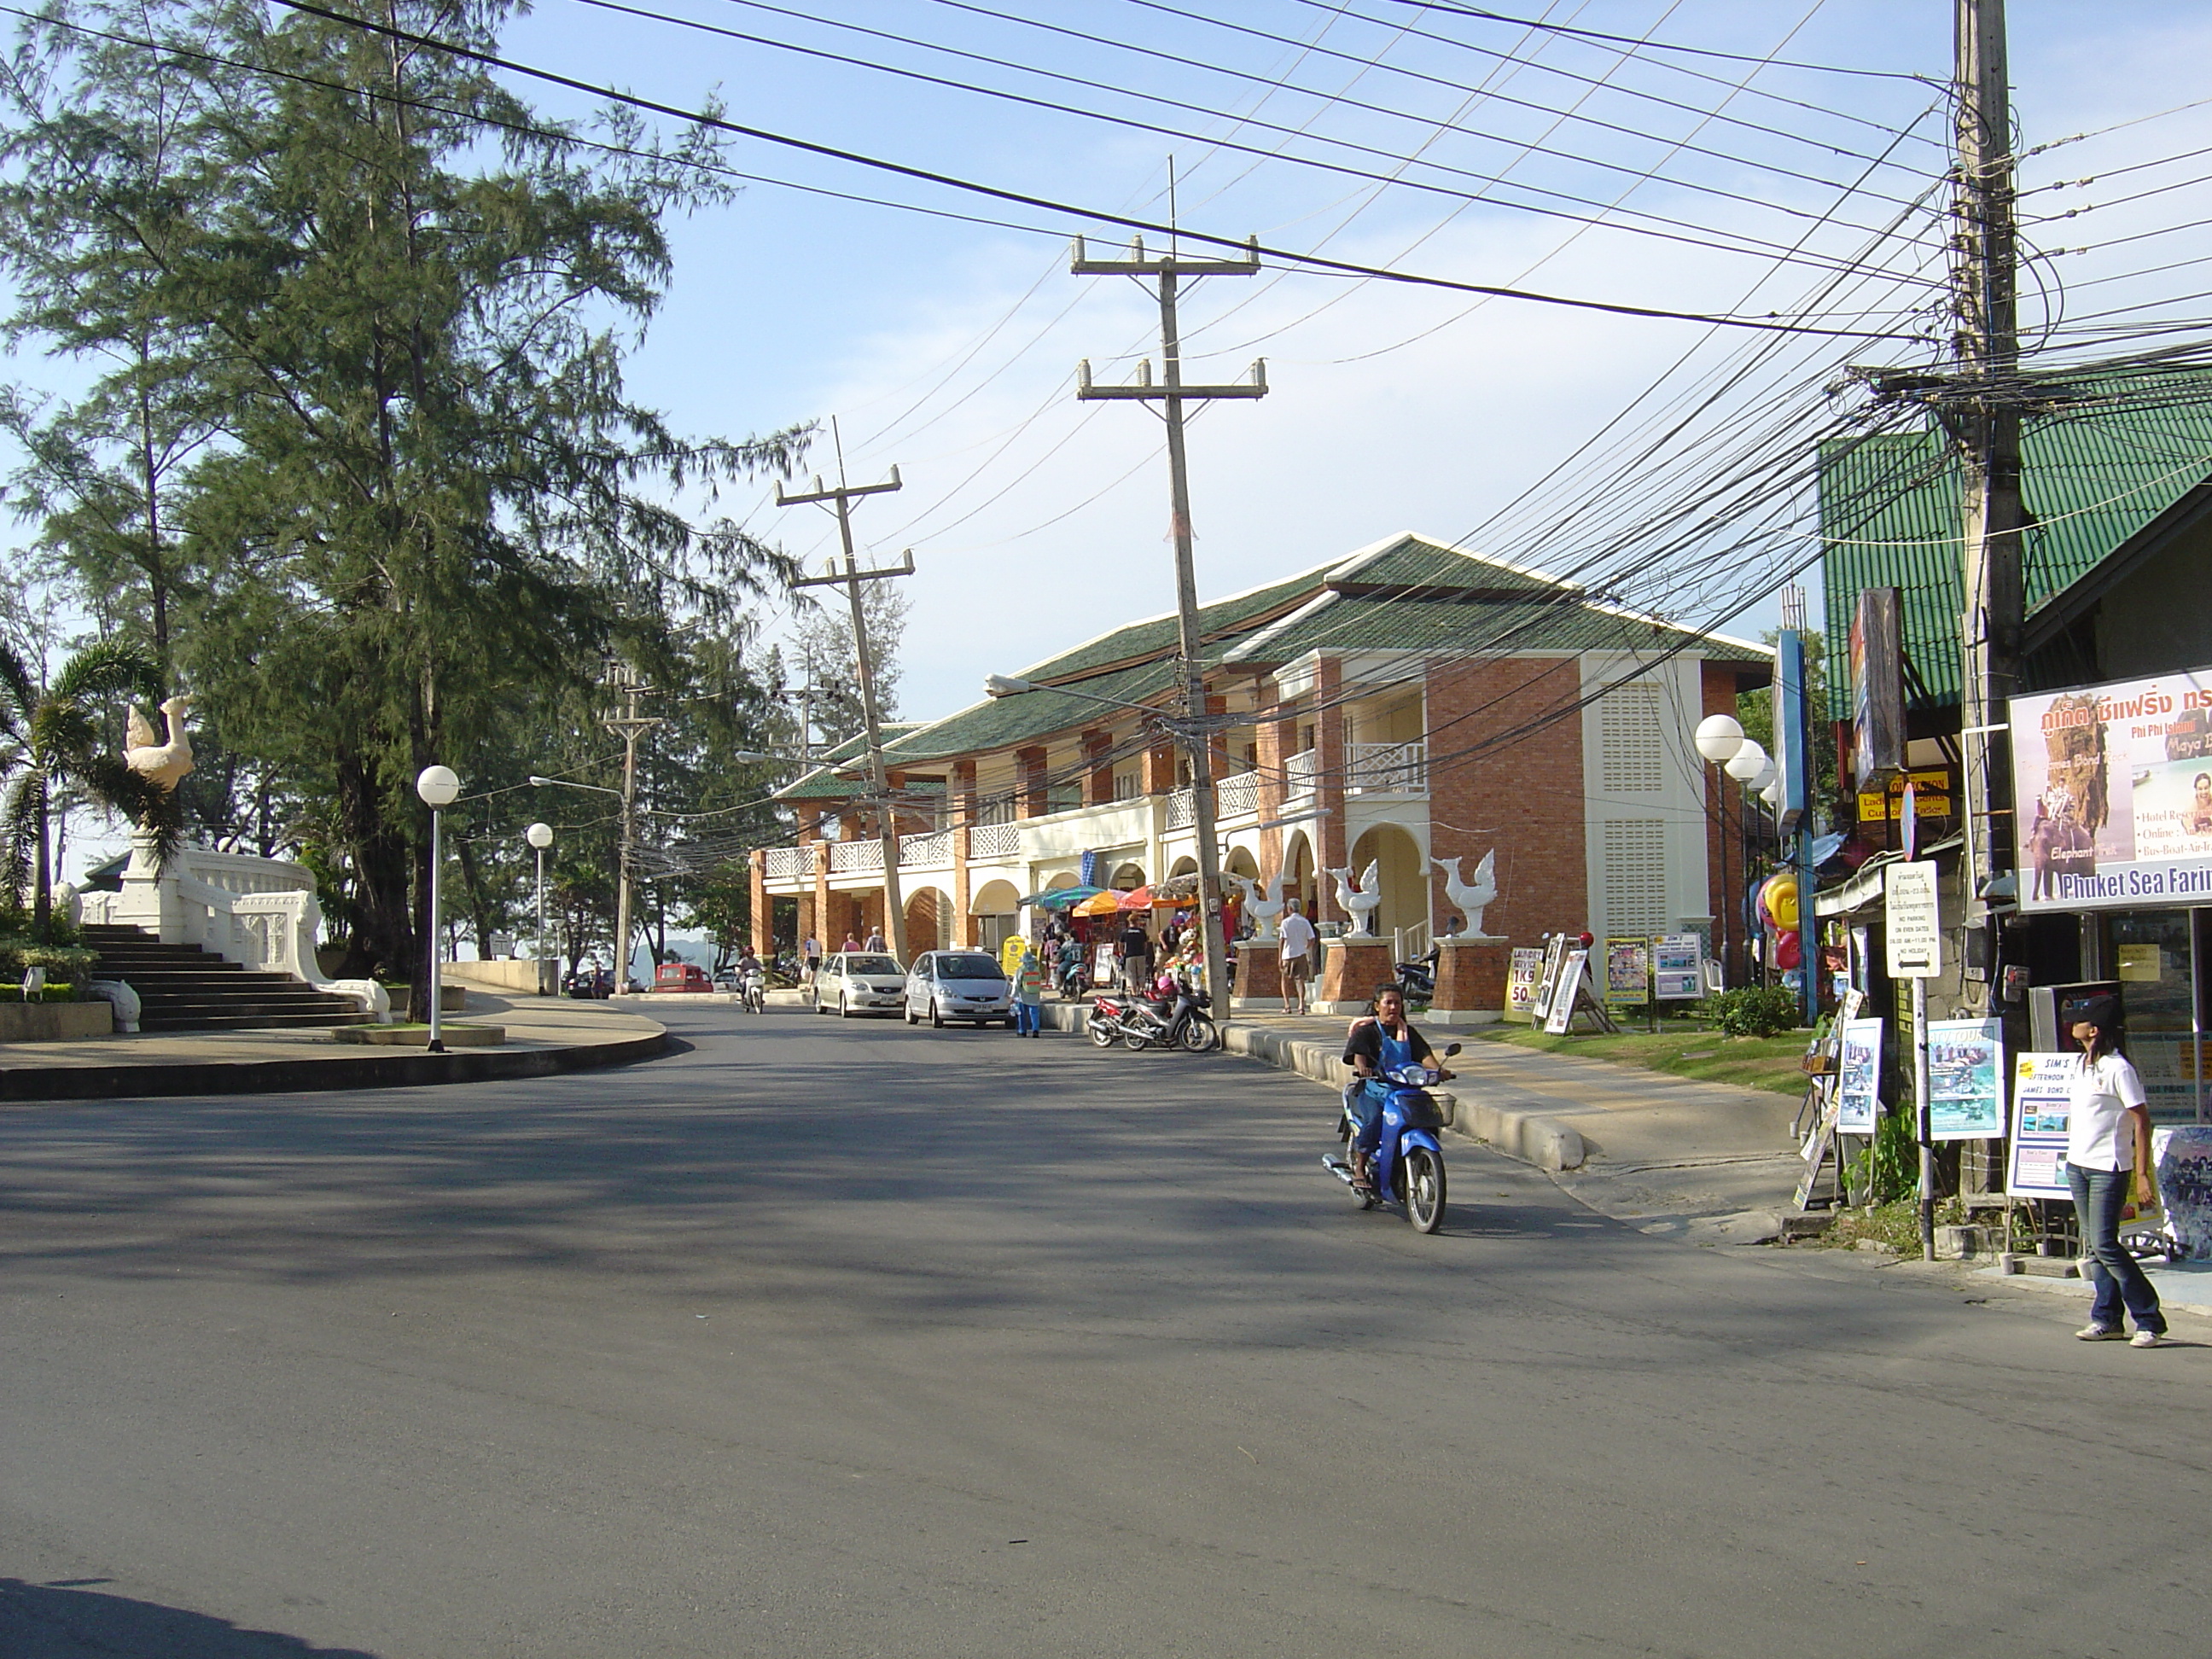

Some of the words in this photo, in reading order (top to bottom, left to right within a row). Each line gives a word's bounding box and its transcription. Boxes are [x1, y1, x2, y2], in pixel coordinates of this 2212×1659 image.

[2131, 725, 2145, 739] Phi
[2148, 724, 2163, 737] Phi
[2165, 719, 2196, 735] Island
[2168, 736, 2202, 757] Maya
[2142, 810, 2167, 823] Hotel
[2143, 827, 2174, 840] Online
[2051, 846, 2094, 864] Elephant
[2063, 873, 2126, 900] Phuket
[2129, 870, 2164, 896] Sea
[1071, 949, 1081, 962] 13
[1514, 949, 1542, 959] LAUNDRY
[1513, 959, 1536, 969] SERVICE
[1512, 986, 1528, 1002] 50
[2045, 1058, 2070, 1068] SIM'S
[2023, 1086, 2043, 1094] JAMES
